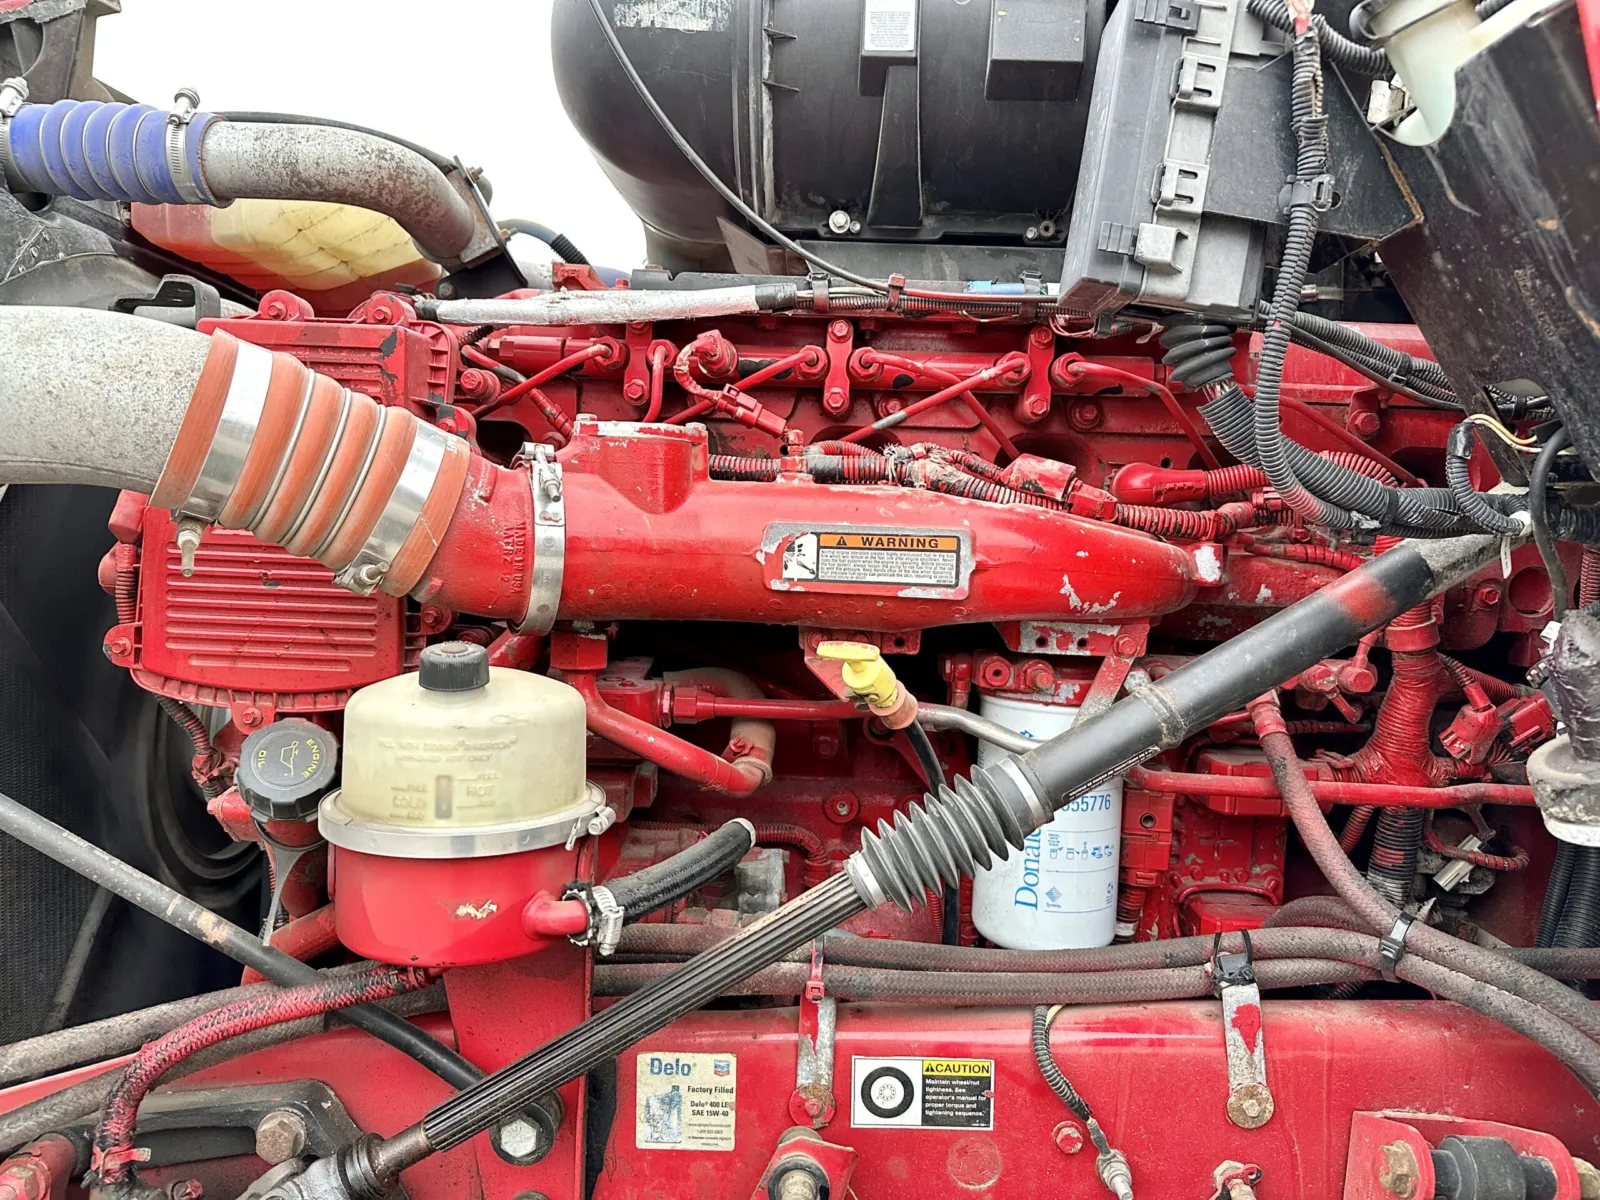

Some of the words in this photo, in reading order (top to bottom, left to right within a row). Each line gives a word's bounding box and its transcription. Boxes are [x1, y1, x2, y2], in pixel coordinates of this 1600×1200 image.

[861, 536, 940, 548] WARNING
[258, 750, 266, 768] OIL
[302, 738, 319, 777] ENGINE
[466, 785, 494, 797] HOT
[393, 795, 425, 808] COLD
[1014, 828, 1041, 910] Donal
[935, 1063, 989, 1074] CAUTION
[688, 1086, 712, 1094] Factory
